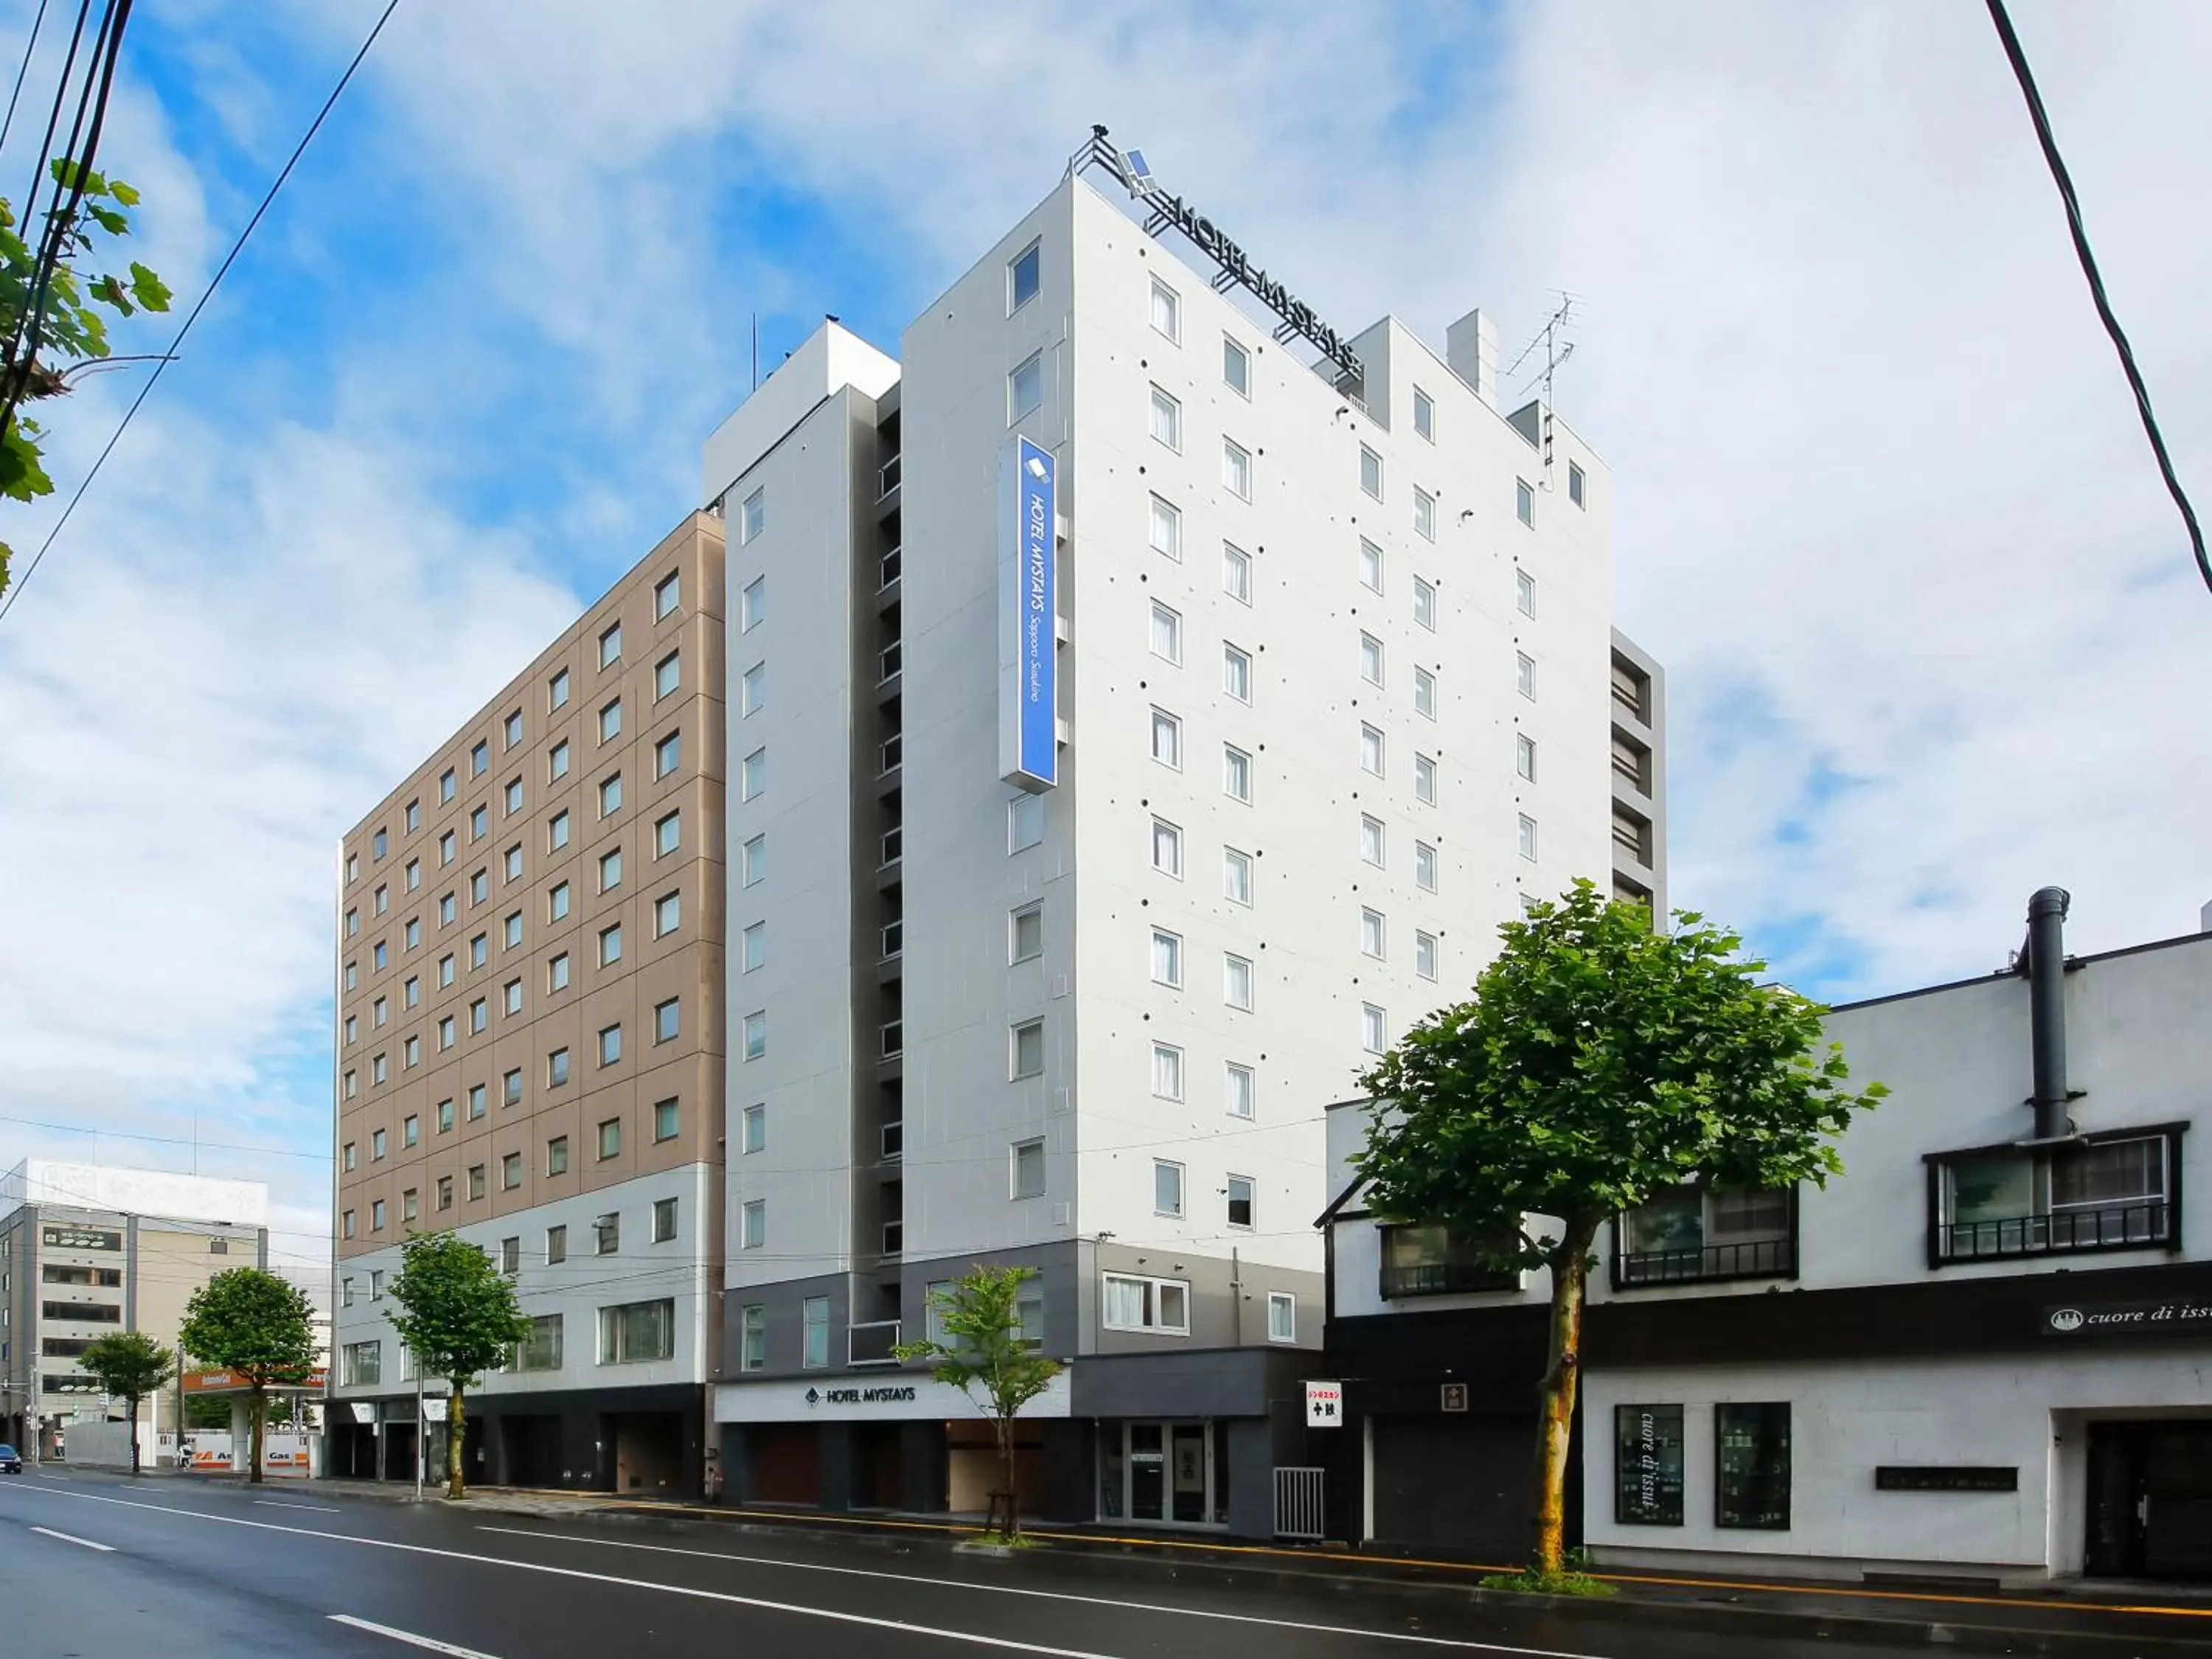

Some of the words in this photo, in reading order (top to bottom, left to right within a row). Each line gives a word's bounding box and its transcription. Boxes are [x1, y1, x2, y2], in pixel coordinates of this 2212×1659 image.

[1174, 195, 1256, 286] HOTEL
[1256, 268, 1363, 375] MYSTAYS
[1031, 493, 1045, 541] HOTEL
[1031, 542, 1045, 613] MYSTAYS
[1029, 613, 1041, 657] Sapporo
[2087, 1312, 2145, 1324] cuore
[2150, 1305, 2174, 1321] di
[827, 1389, 861, 1404] HOTEL
[862, 1387, 916, 1402] MYSTAYS
[1641, 1413, 1655, 1452] cuore
[268, 1451, 290, 1461] Gas
[1642, 1455, 1659, 1471] di
